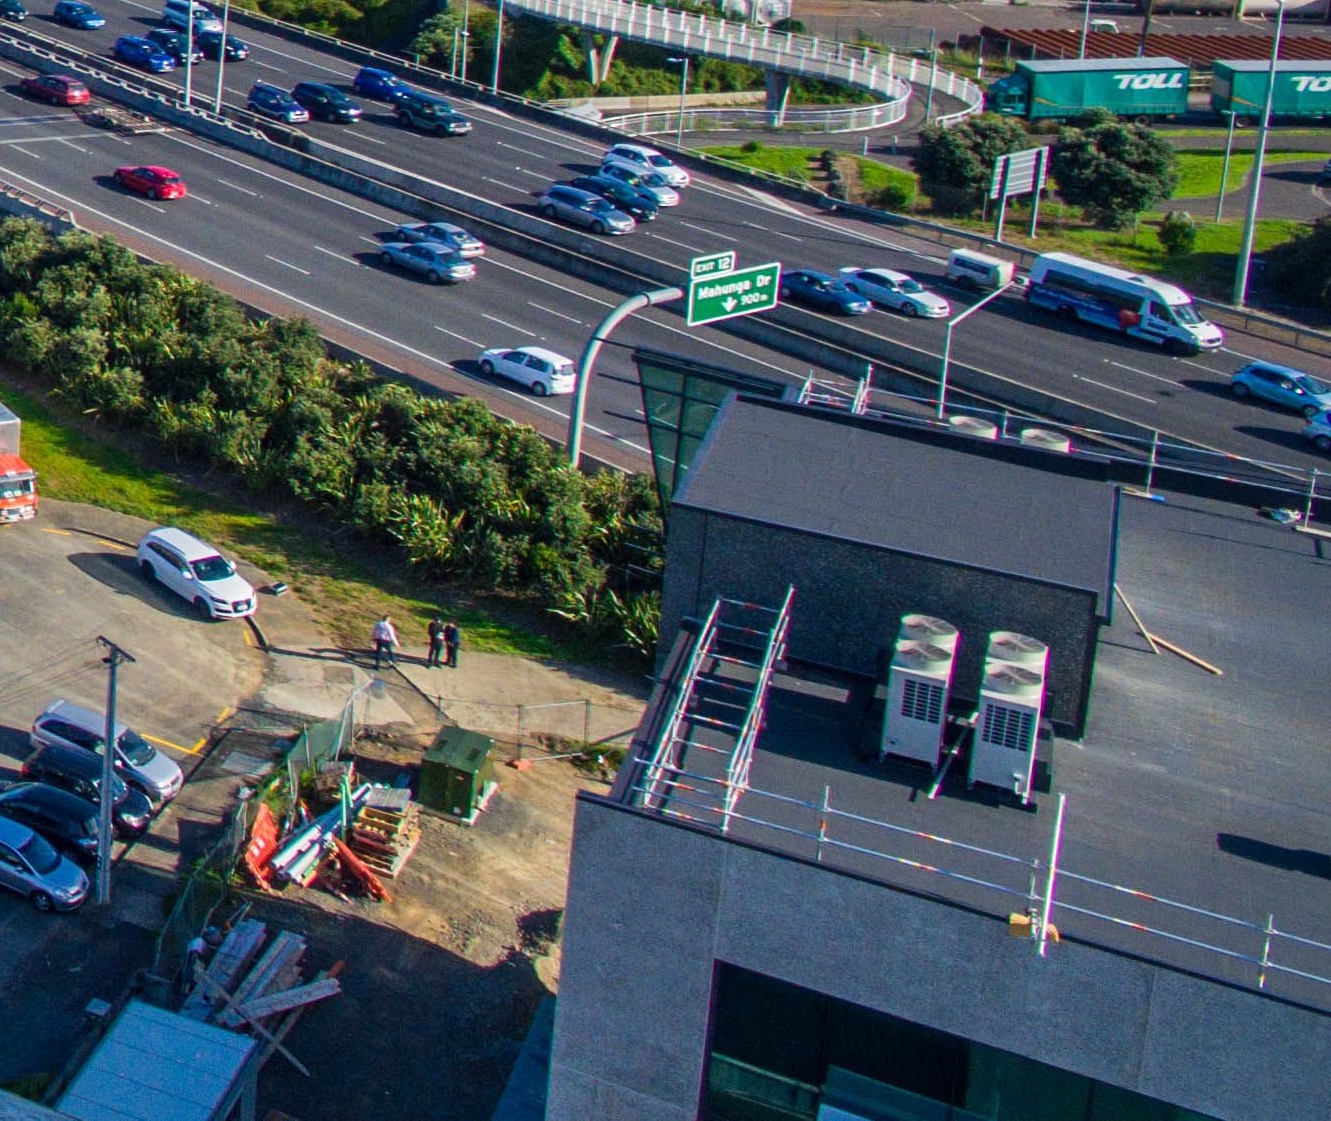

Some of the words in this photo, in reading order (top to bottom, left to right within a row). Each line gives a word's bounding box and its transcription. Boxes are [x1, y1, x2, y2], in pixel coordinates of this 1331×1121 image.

[1113, 72, 1183, 90] TOLL
[696, 261, 716, 273] EXIT
[718, 257, 731, 270] 12
[697, 280, 752, 300] Mahunga
[756, 275, 772, 288] Dr
